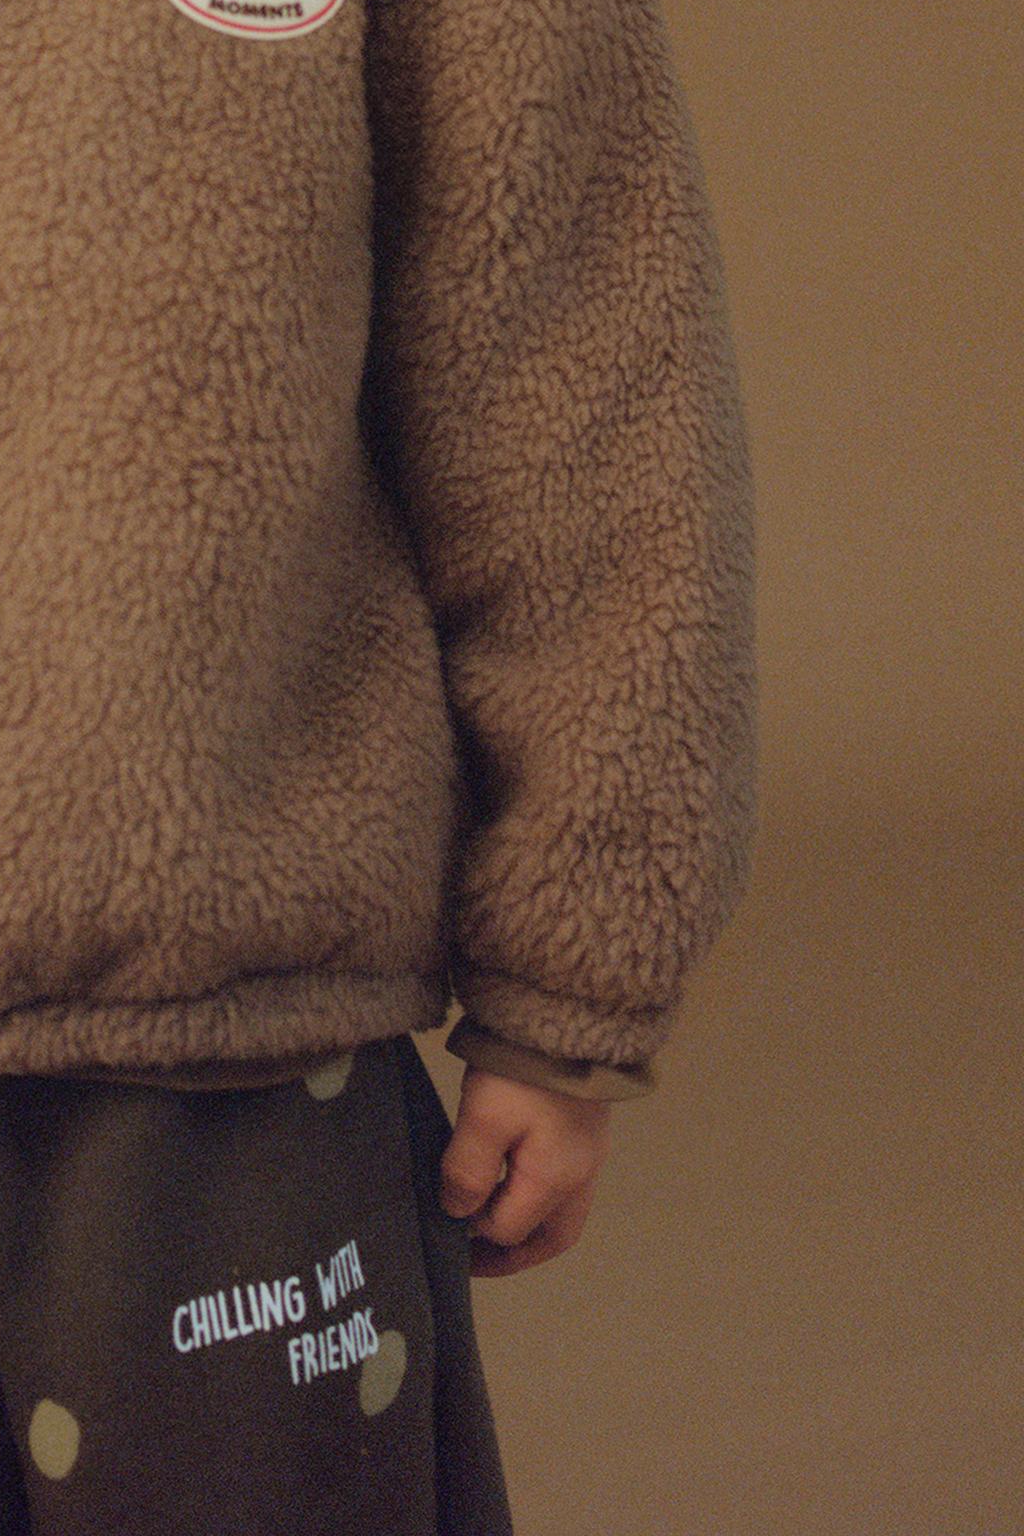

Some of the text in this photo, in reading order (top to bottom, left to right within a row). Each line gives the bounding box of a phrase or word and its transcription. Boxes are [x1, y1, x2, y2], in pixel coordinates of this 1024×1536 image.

[173, 1239, 365, 1353] CHILLING WITH
[287, 1307, 379, 1386] FRIENDS
